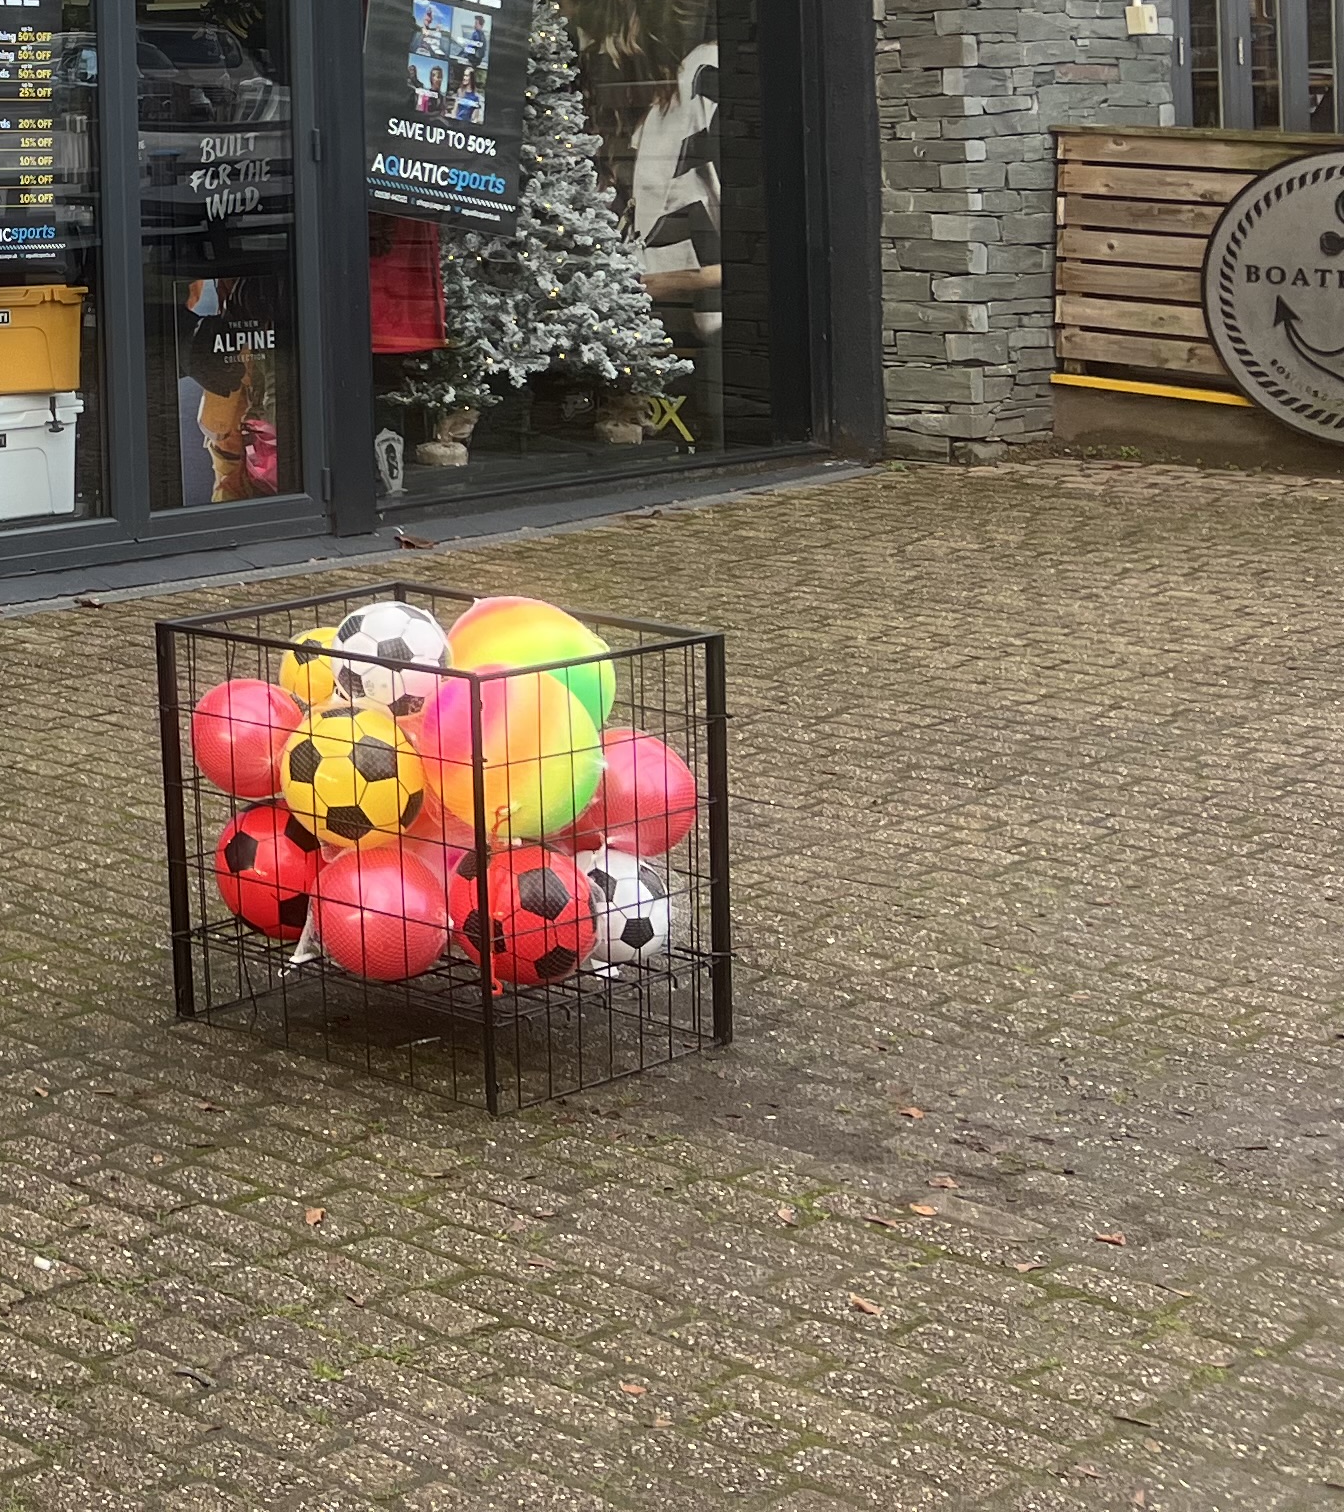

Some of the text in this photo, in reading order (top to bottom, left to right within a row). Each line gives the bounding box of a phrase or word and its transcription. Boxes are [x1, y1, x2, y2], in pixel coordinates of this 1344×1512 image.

[18, 32, 35, 42] 50%
[36, 32, 52, 41] OFF
[18, 51, 35, 60] 50%
[36, 51, 52, 60] OFF
[18, 69, 35, 79] 50%
[36, 69, 52, 78] OFF
[19, 88, 36, 97] 25%
[37, 88, 53, 97] OFF
[18, 119, 36, 129] 20%
[37, 119, 53, 128] OFF
[20, 138, 36, 147] 15%
[37, 138, 53, 147] OFF
[388, 118, 497, 157] SAVE UP TO 50%
[200, 133, 260, 163] BUILT
[19, 157, 36, 166] 10%
[37, 156, 53, 165] OFF
[190, 157, 271, 192] FOR THE
[371, 153, 506, 195] AQUATICsports
[19, 175, 37, 184] 10%
[37, 175, 53, 184] OFF
[19, 194, 37, 203] 10%
[37, 194, 54, 203] OFF
[206, 186, 263, 222] WILD.
[244, 319, 259, 328] NEW
[213, 330, 275, 353] ALPINE
